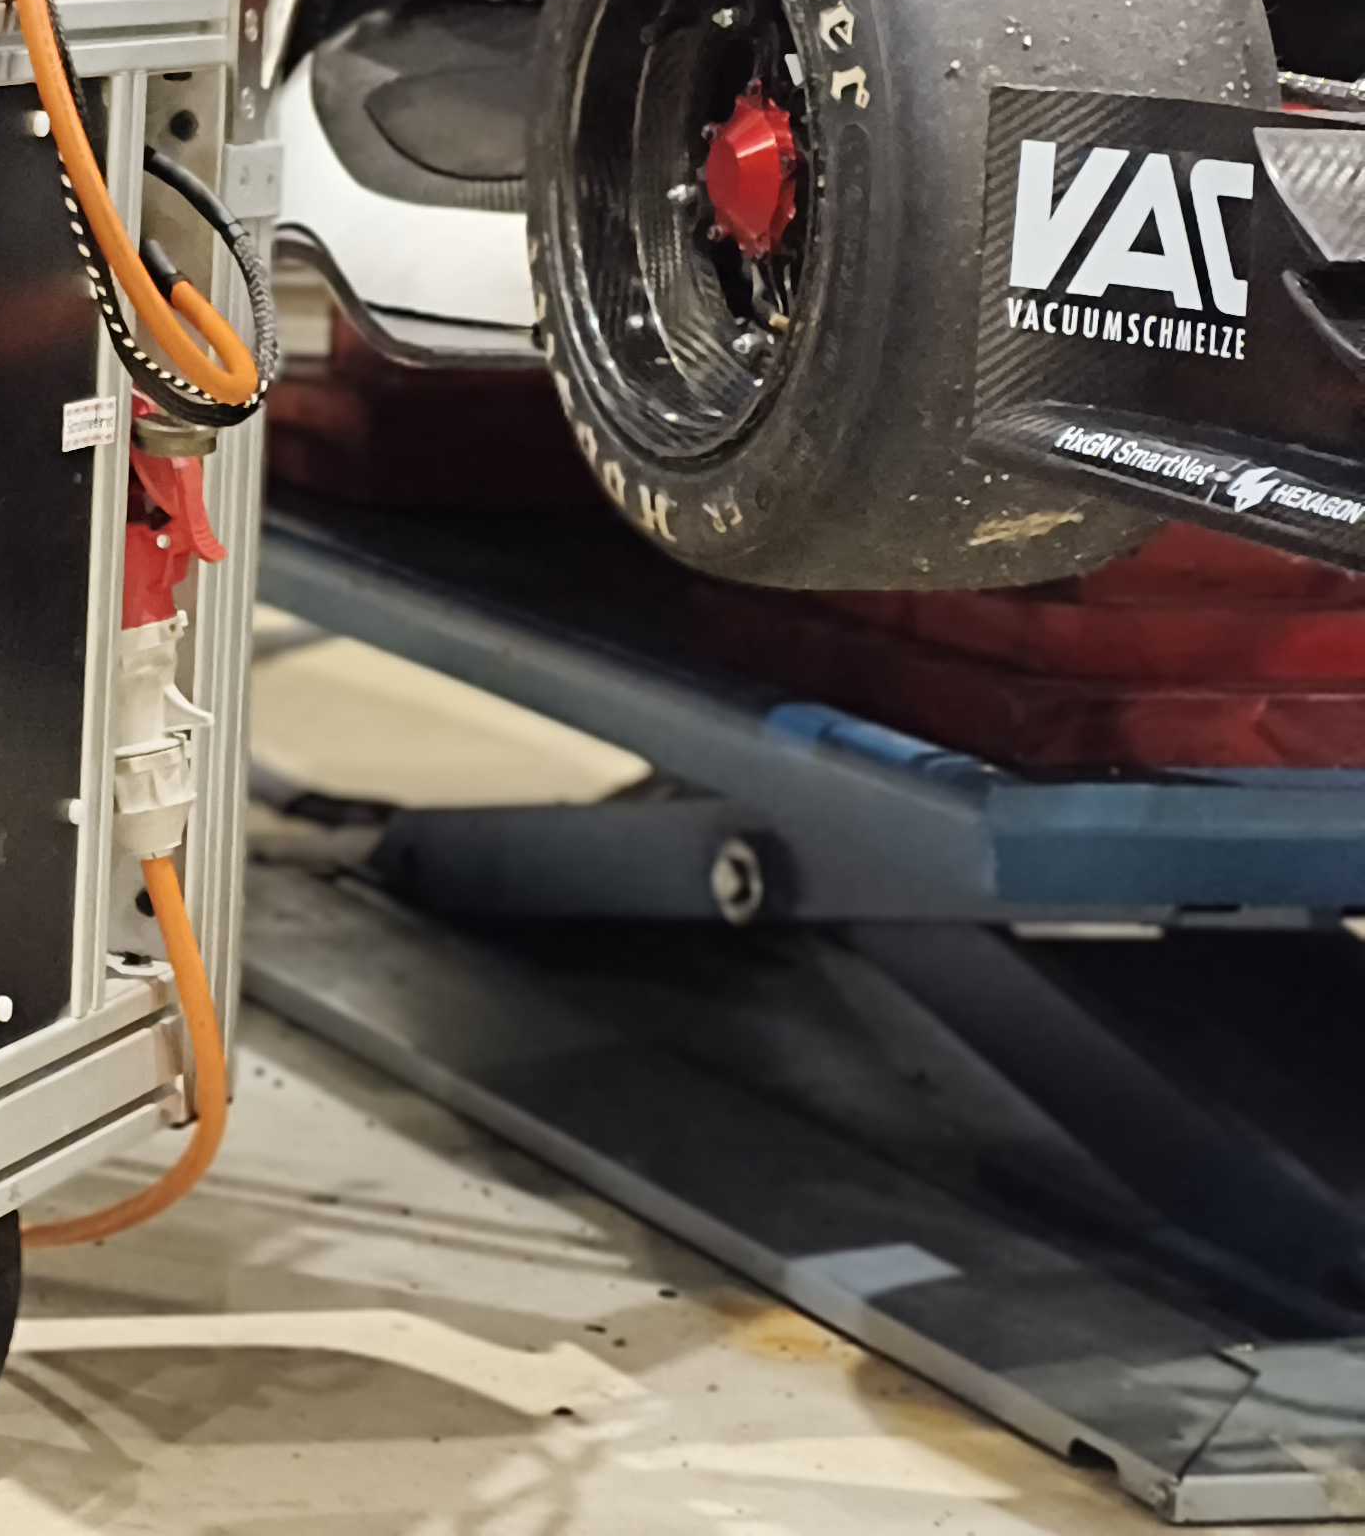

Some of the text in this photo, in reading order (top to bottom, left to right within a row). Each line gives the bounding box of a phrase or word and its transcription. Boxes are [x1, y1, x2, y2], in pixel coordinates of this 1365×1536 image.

[1009, 139, 1255, 317] VAC
[1007, 296, 1247, 360] VACUUMSCHMELZE
[1054, 425, 1365, 524] HxGN SmartNet HEXAGON
